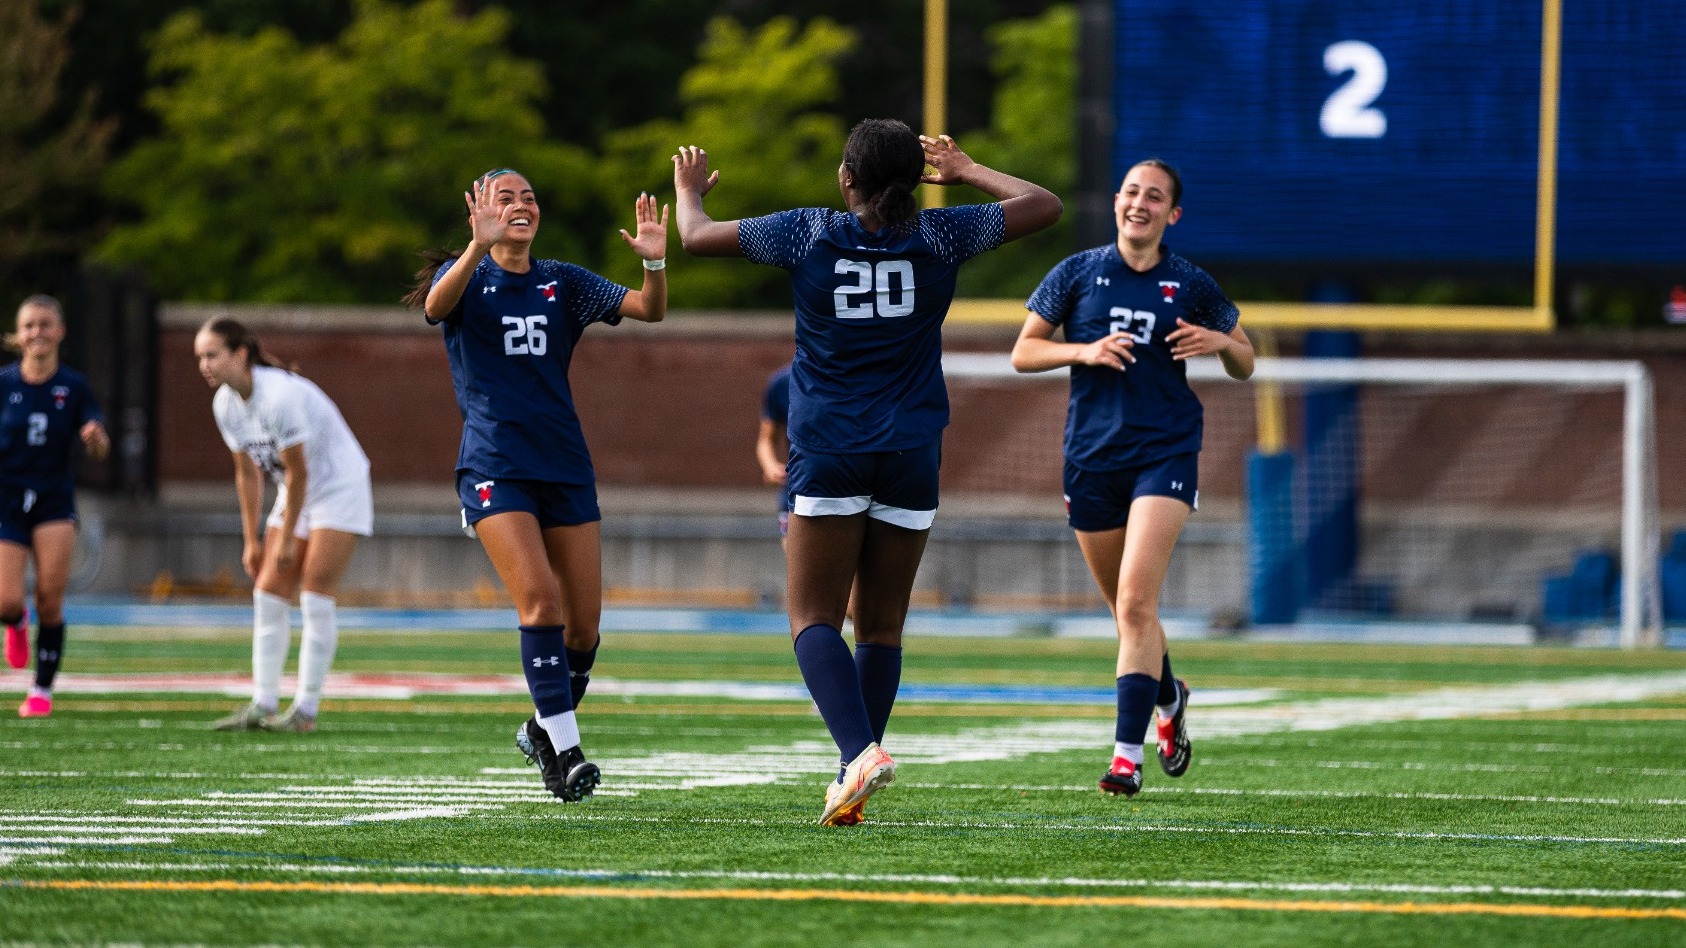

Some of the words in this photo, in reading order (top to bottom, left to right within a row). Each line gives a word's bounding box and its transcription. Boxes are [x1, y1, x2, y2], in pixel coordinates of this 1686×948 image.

[1319, 39, 1388, 139] 2
[833, 258, 916, 319] 20
[501, 314, 548, 356] 26
[1109, 306, 1157, 345] 23
[27, 411, 48, 446] 2
